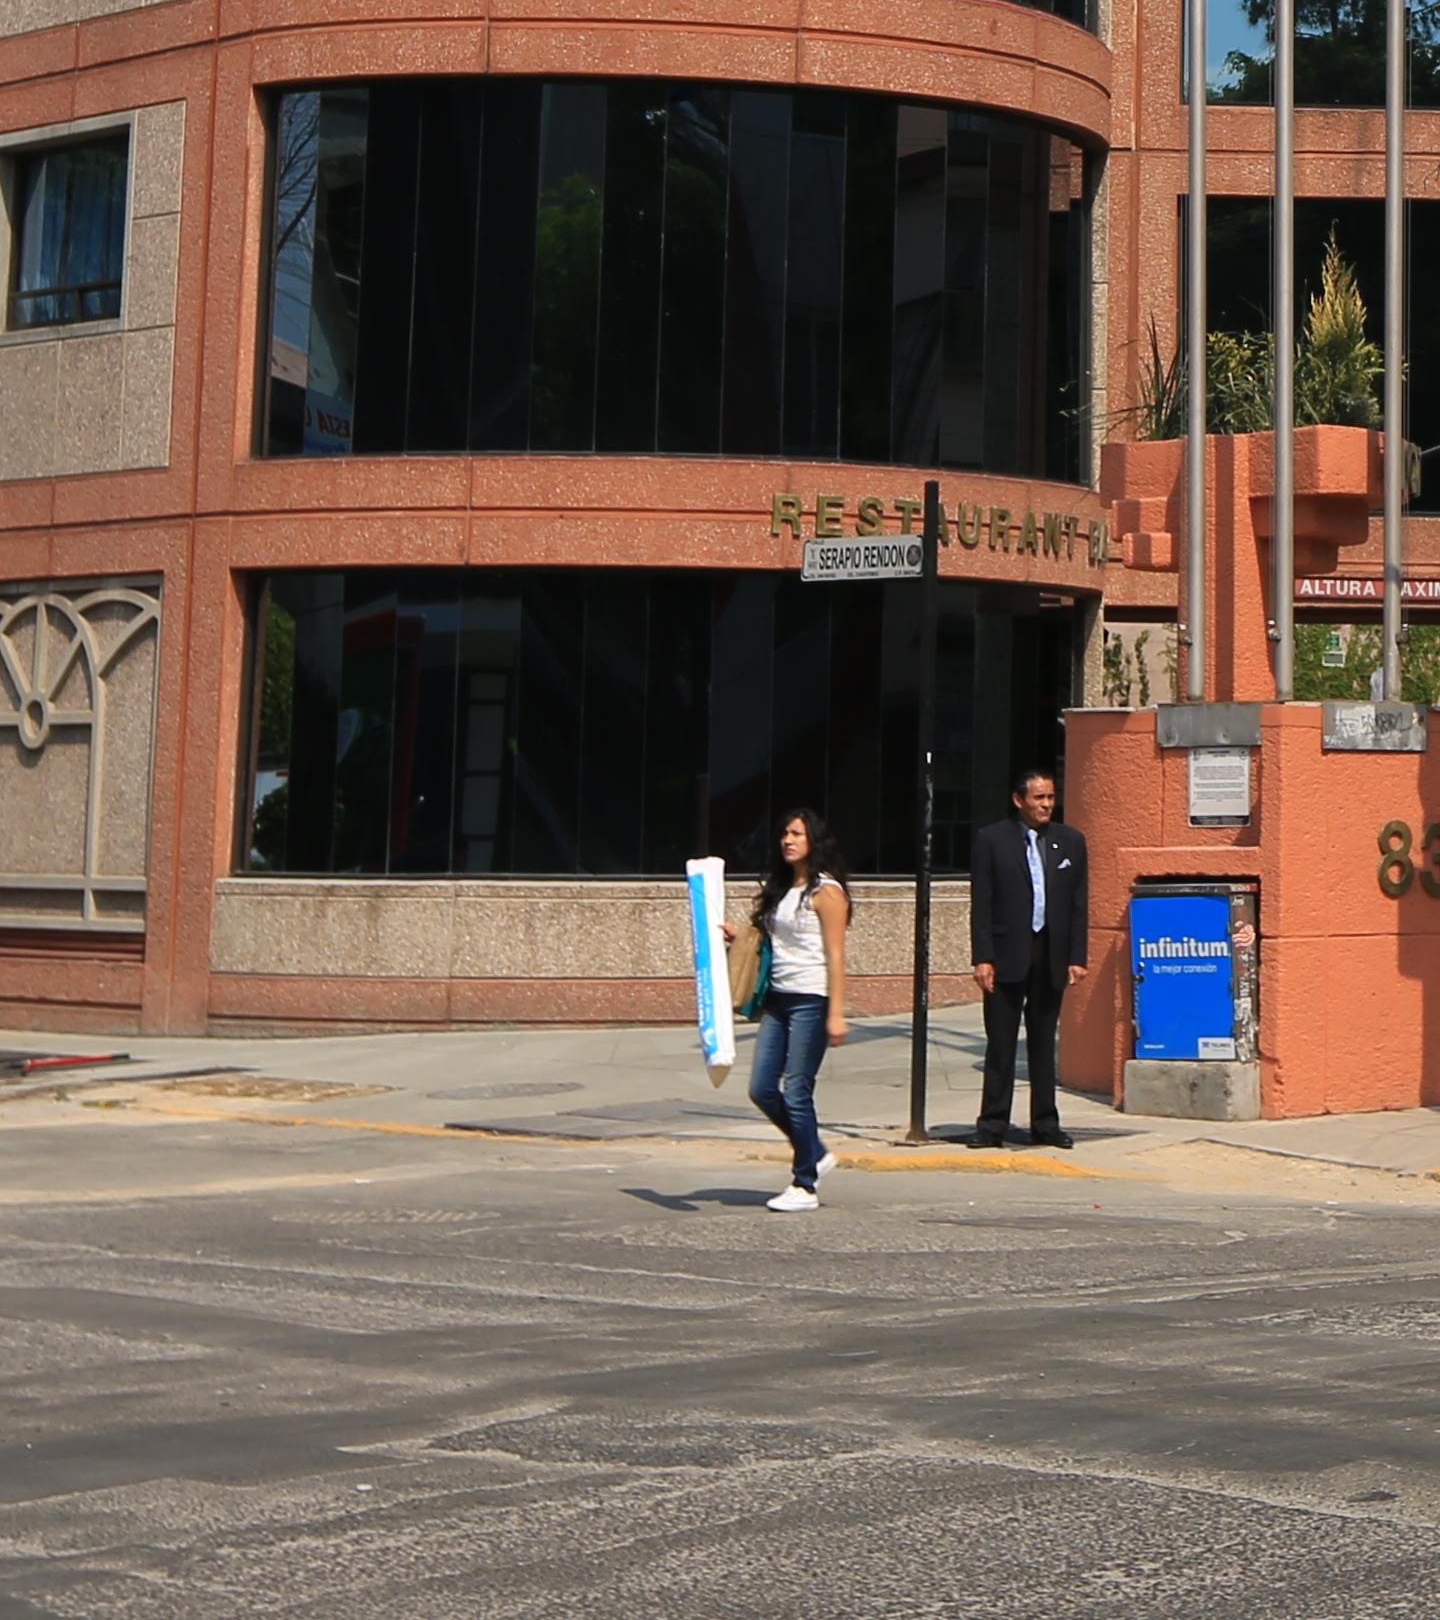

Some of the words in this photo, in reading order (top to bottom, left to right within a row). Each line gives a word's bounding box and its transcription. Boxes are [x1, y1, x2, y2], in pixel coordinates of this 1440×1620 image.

[819, 546, 861, 570] SERAPIO
[863, 544, 906, 568] RENDON
[1300, 580, 1376, 596] ALTURA
[1161, 964, 1182, 976] mejor
